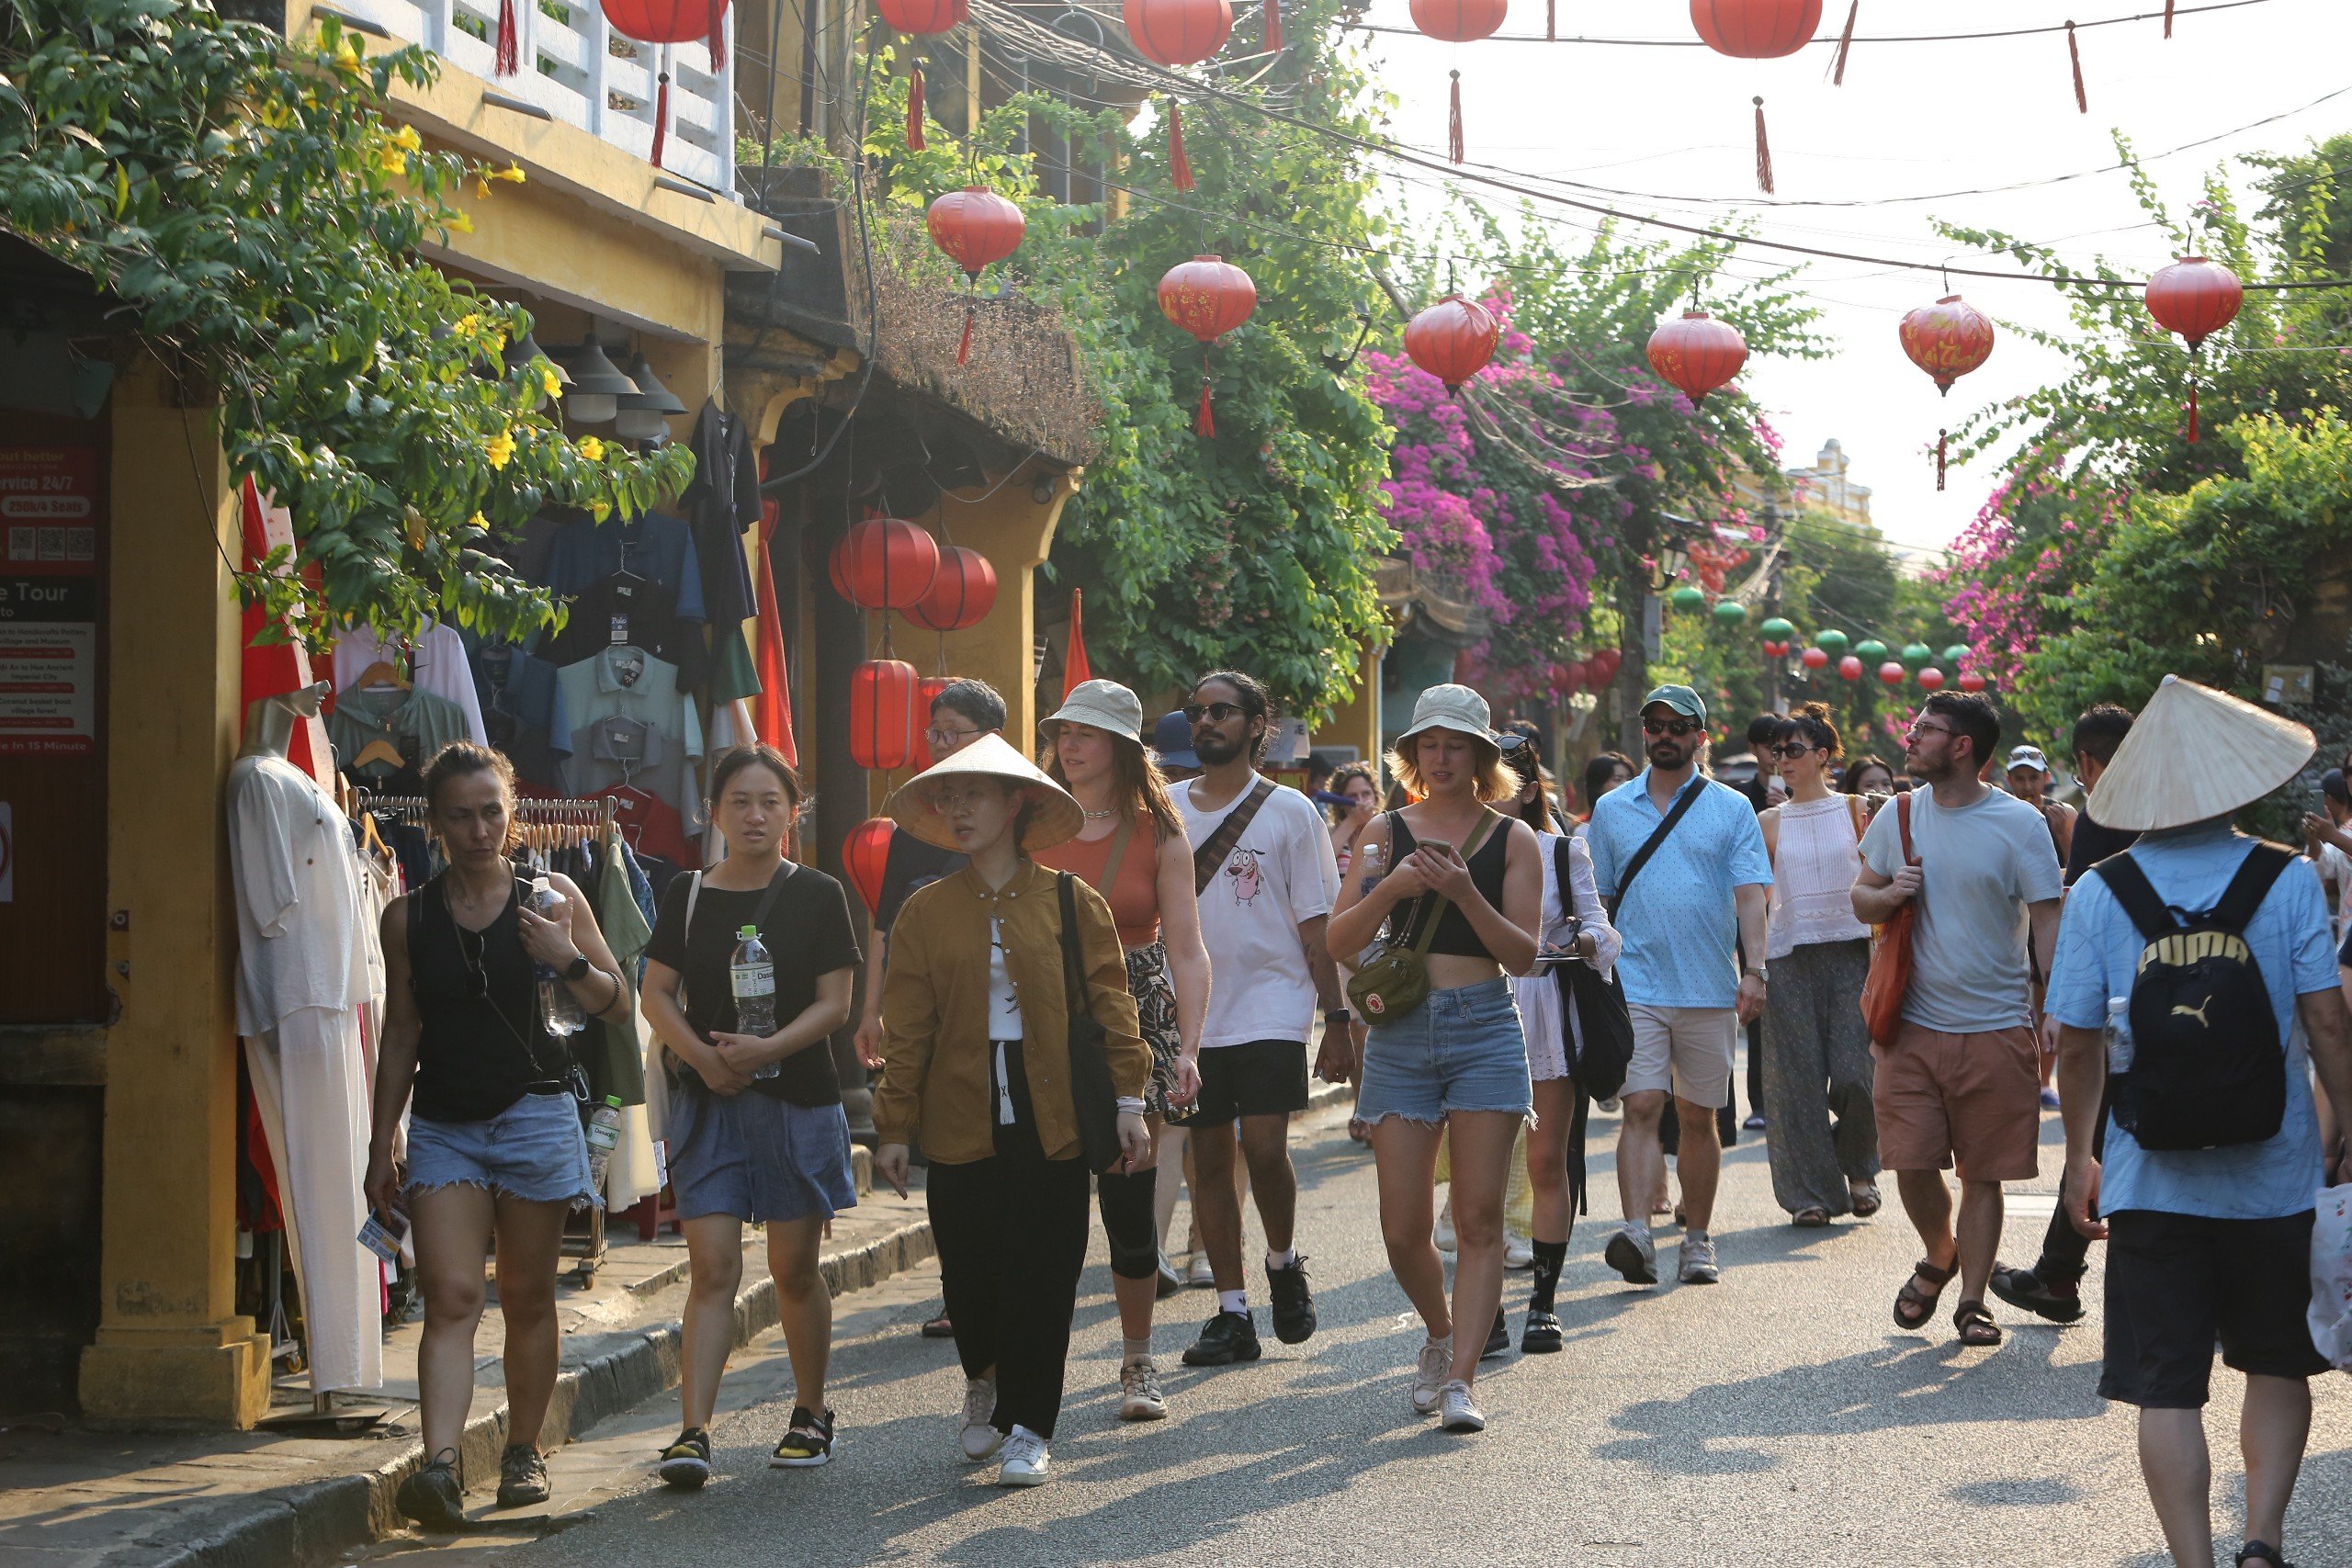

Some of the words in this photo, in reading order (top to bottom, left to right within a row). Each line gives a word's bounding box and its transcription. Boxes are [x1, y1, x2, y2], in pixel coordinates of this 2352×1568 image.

[23, 451, 65, 461] better
[0, 476, 38, 491] rvice
[42, 476, 74, 491] 24/7
[9, 501, 48, 513] 250k/4
[51, 501, 83, 513] Seats
[16, 582, 68, 602] Tour
[0, 607, 14, 616] to
[611, 616, 628, 625] Polo
[28, 741, 40, 750] 15
[44, 741, 87, 750] Minute
[2138, 931, 2249, 976] PUMA
